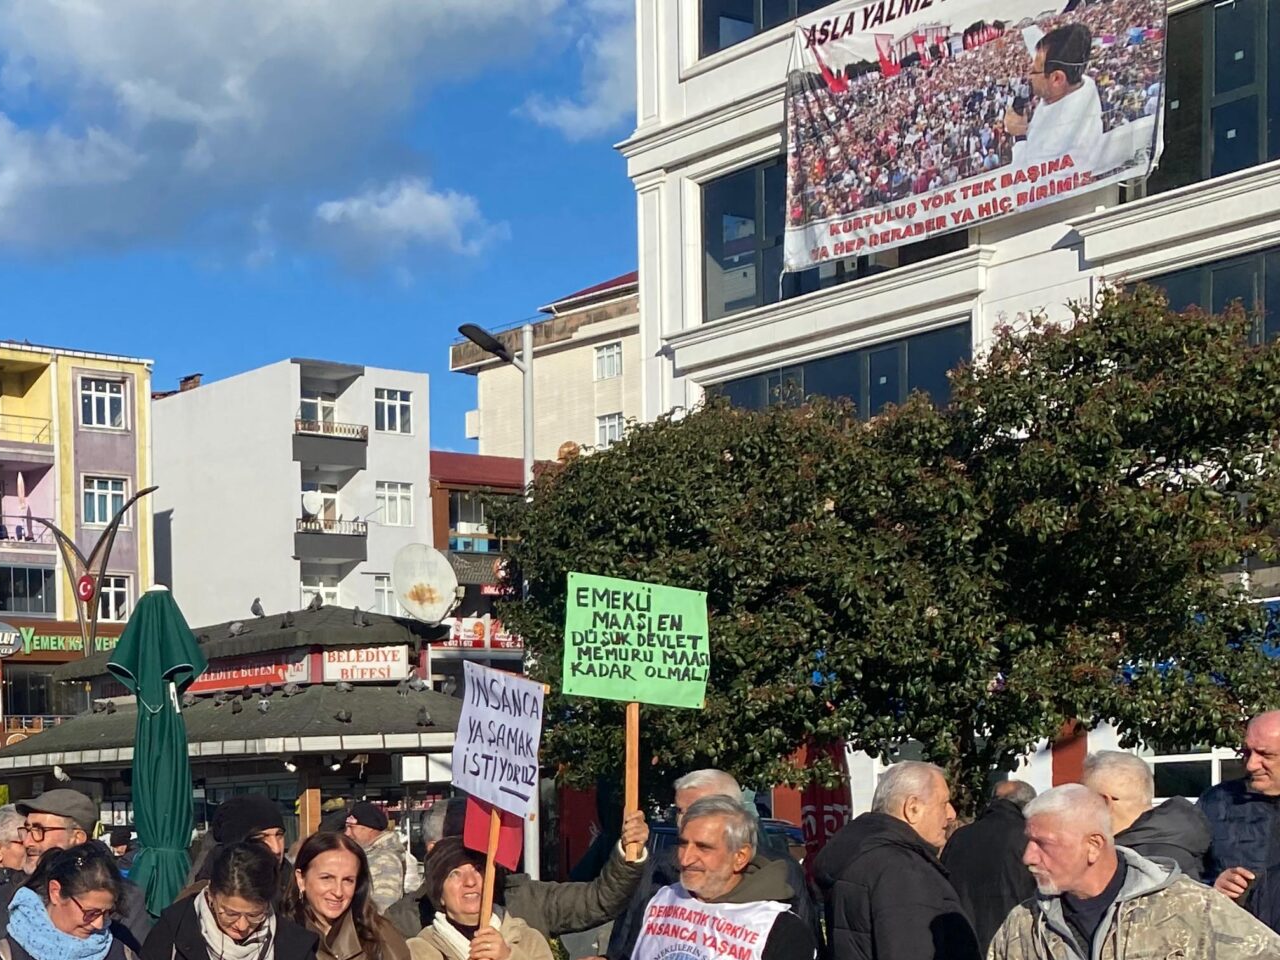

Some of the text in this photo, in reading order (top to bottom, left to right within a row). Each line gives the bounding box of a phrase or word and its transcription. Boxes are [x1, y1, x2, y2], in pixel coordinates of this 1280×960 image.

[805, 11, 855, 49] ASLA
[829, 154, 1075, 237] KURTULUŞ YOK TEK BAŞINA
[869, 214, 948, 248] BERABER
[950, 207, 975, 226] YA
[657, 614, 683, 632] EN
[19, 626, 65, 655] YEMEK
[577, 645, 654, 663] MEMURU
[636, 633, 703, 650] DEVLET
[570, 661, 709, 682] KADAR OLMALI
[462, 746, 537, 787] İSTİYORUZ
[711, 916, 760, 945] TÜRKİYE
